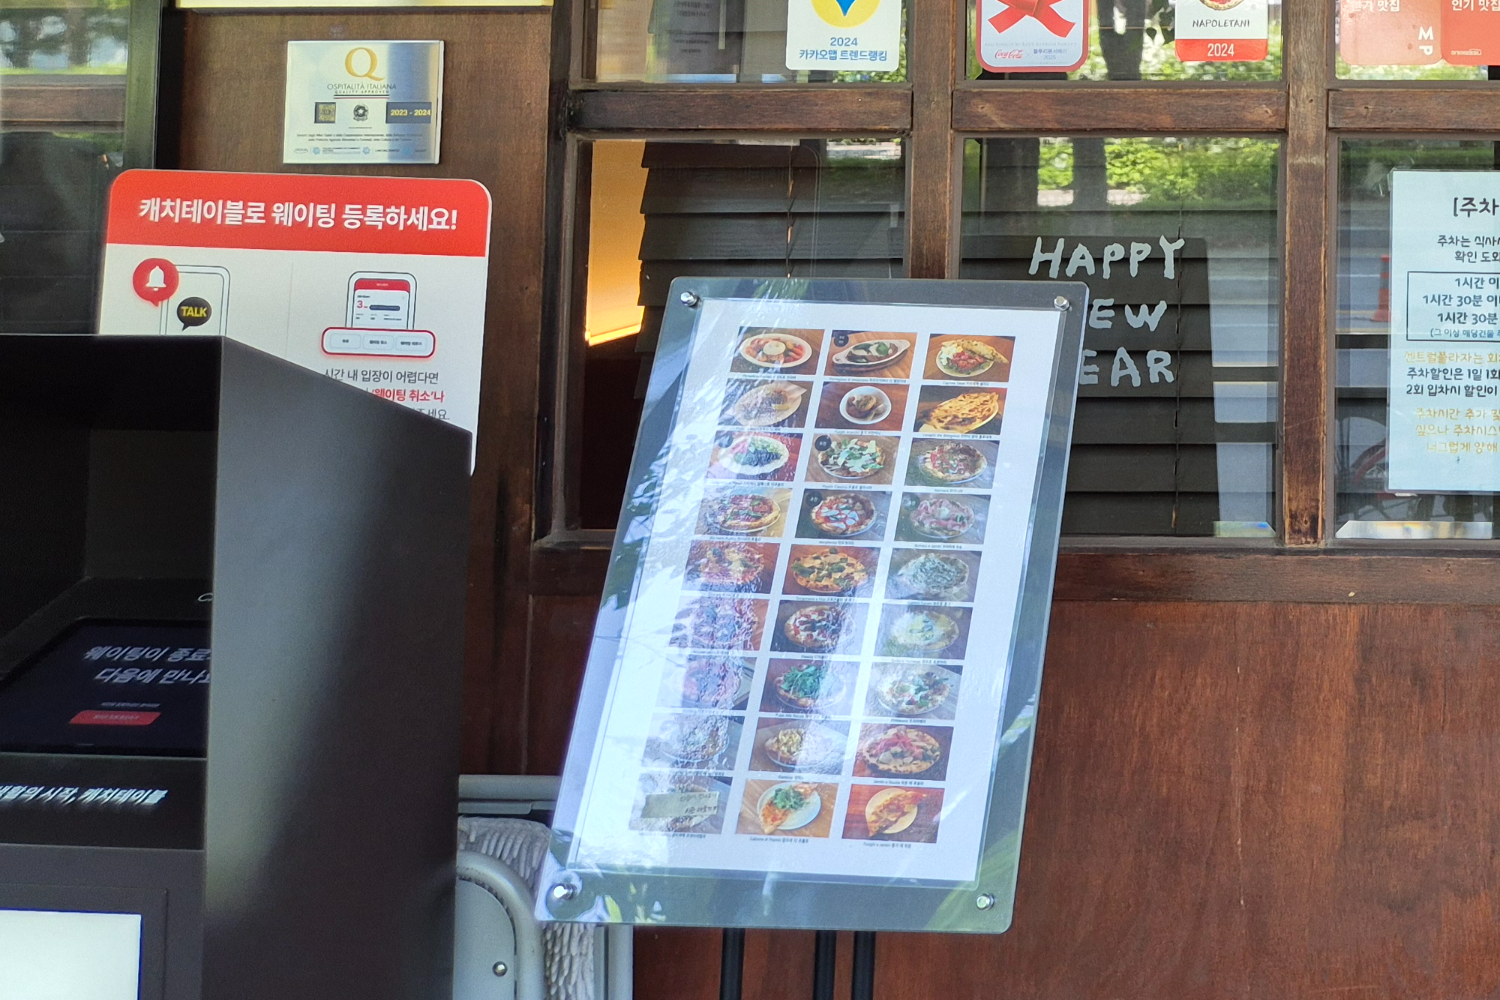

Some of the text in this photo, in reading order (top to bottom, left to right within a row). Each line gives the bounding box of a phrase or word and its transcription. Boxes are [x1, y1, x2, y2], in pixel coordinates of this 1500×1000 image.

[1350, 0, 1400, 12] 인기 맛집
[1452, 0, 1500, 11] 인기 맛집
[830, 37, 857, 46] 2024
[800, 50, 887, 61] 카카오맵 트렌드랭킹
[1208, 44, 1234, 56] 2024
[1454, 197, 1499, 217] [주차
[139, 198, 457, 231] 캐치테이블로 웨이팅 등록하세요!
[1437, 235, 1471, 247] 주차는
[1029, 235, 1185, 279] HAPPY
[1455, 251, 1477, 263] 확인
[1455, 277, 1485, 289] 1시간
[1423, 294, 1453, 306] 1시간
[1457, 295, 1482, 307] 30분
[181, 305, 207, 319] TALK
[1088, 298, 1167, 331] EW
[1438, 312, 1467, 324] 1시간
[1472, 313, 1498, 325] 30분
[1080, 347, 1174, 387] EAR
[1407, 367, 1463, 380] 주차할인은
[348, 370, 358, 381] 내
[361, 370, 392, 382] 입장이
[396, 371, 438, 384] 어렵다면
[1406, 384, 1423, 395] 2회
[1428, 385, 1460, 396] 입차시
[1464, 385, 1497, 397] 할인이
[84, 646, 169, 661] 웨이팅이
[95, 668, 163, 683] 다음에
[78, 788, 167, 805] 캐치테이블
